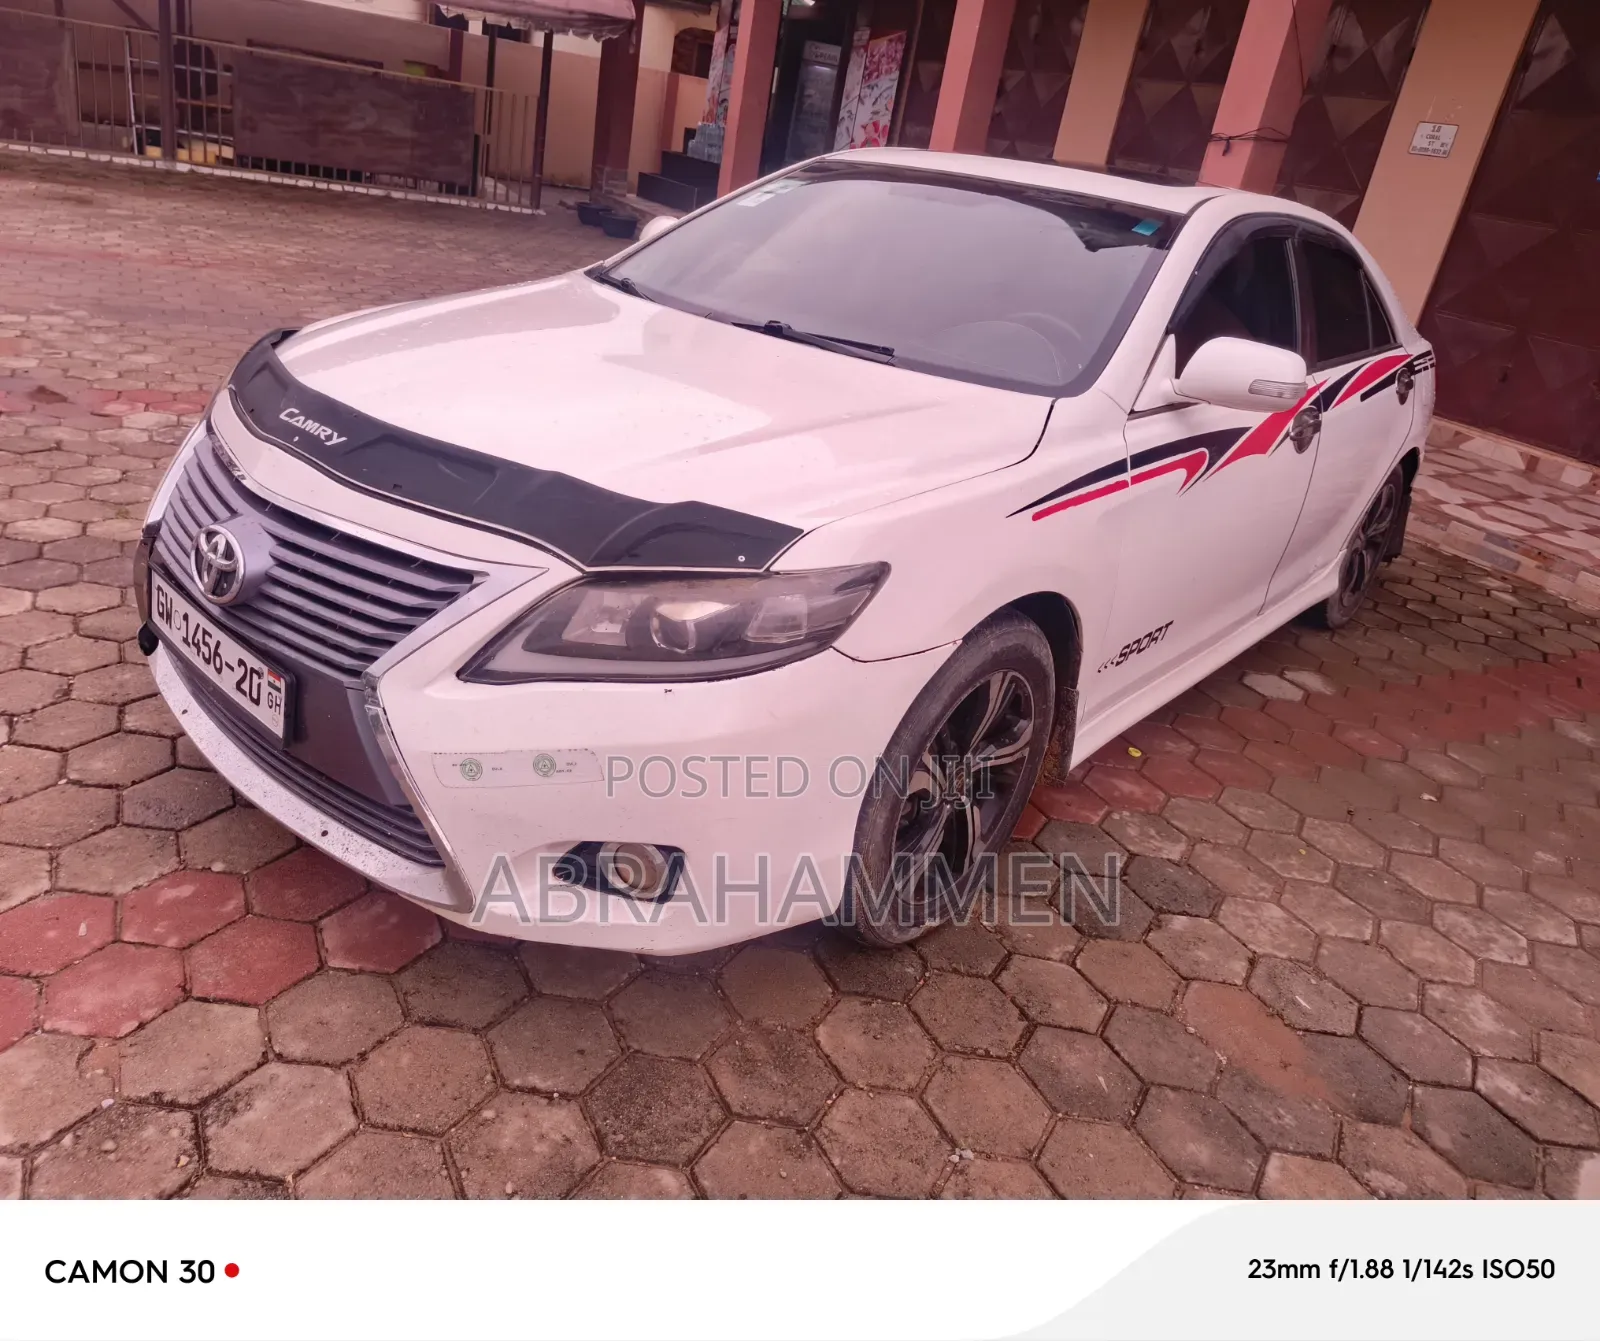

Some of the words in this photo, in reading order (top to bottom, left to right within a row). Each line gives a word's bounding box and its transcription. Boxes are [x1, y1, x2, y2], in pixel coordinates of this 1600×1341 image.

[279, 407, 348, 446] CAMRY
[156, 584, 173, 631] GW
[181, 611, 263, 707] 1456-20
[1115, 619, 1175, 668] SPORT
[267, 691, 281, 716] GH
